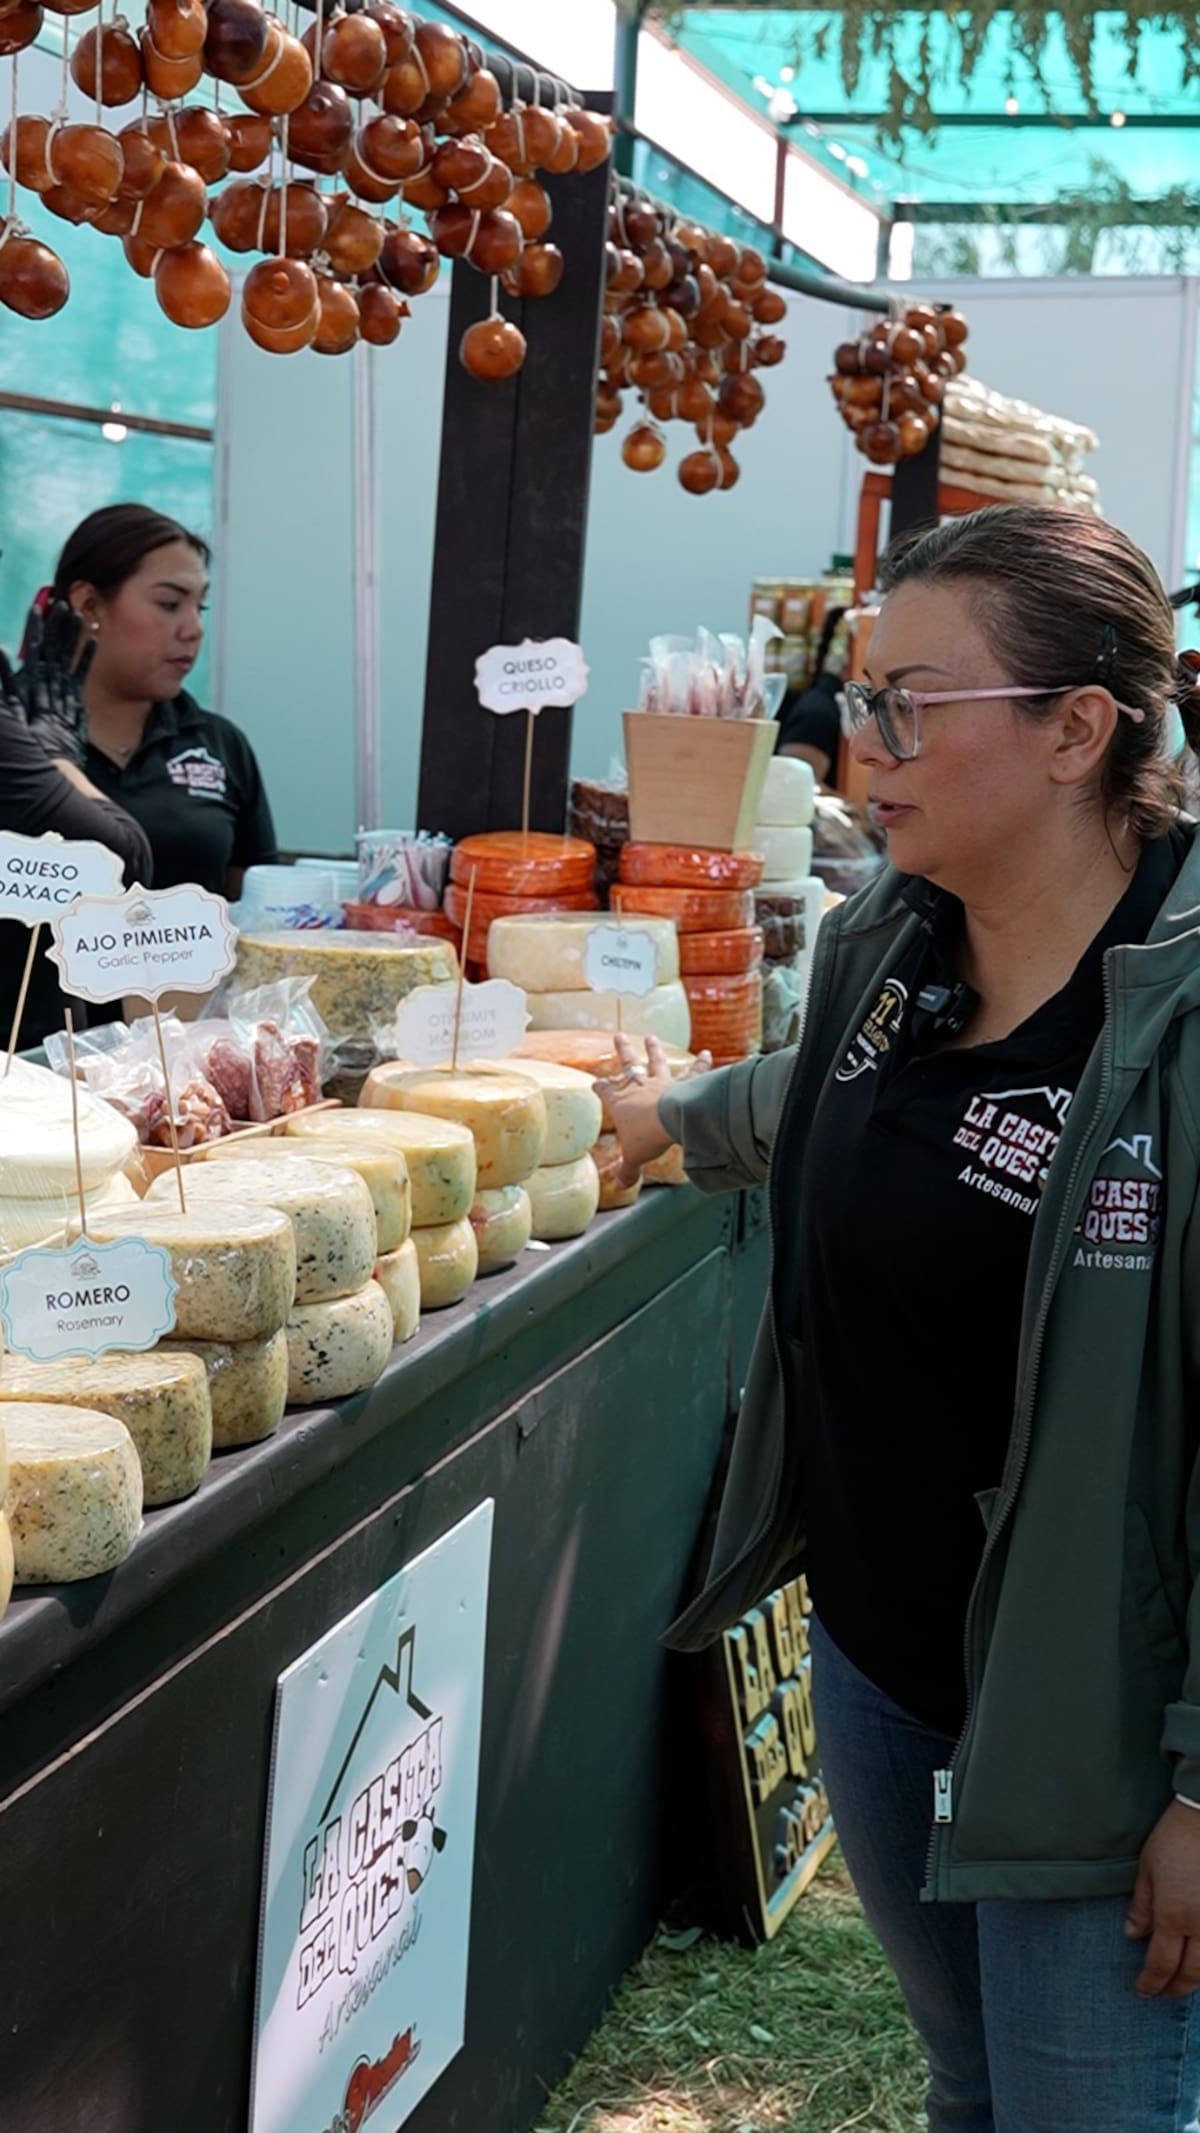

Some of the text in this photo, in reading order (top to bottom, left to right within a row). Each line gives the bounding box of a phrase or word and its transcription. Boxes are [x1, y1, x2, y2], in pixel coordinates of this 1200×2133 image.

[503, 657, 557, 675] QUESO
[499, 676, 566, 695] CRIOLLO
[7, 858, 78, 881] QUESO
[75, 924, 213, 954] AJO PIMIENTA
[97, 949, 194, 969] Garlic Pepper
[953, 1127, 982, 1151] DEL
[963, 1096, 1060, 1161] LA CASIT
[957, 1165, 1040, 1215] Artesanal
[1091, 1180, 1160, 1212] CASIT
[1073, 1247, 1153, 1270] Artesan
[46, 1284, 130, 1311] ROMERO
[57, 1314, 124, 1332] Rosemary
[299, 1716, 444, 1934] LA CASITA
[297, 1917, 334, 2011] DEL
